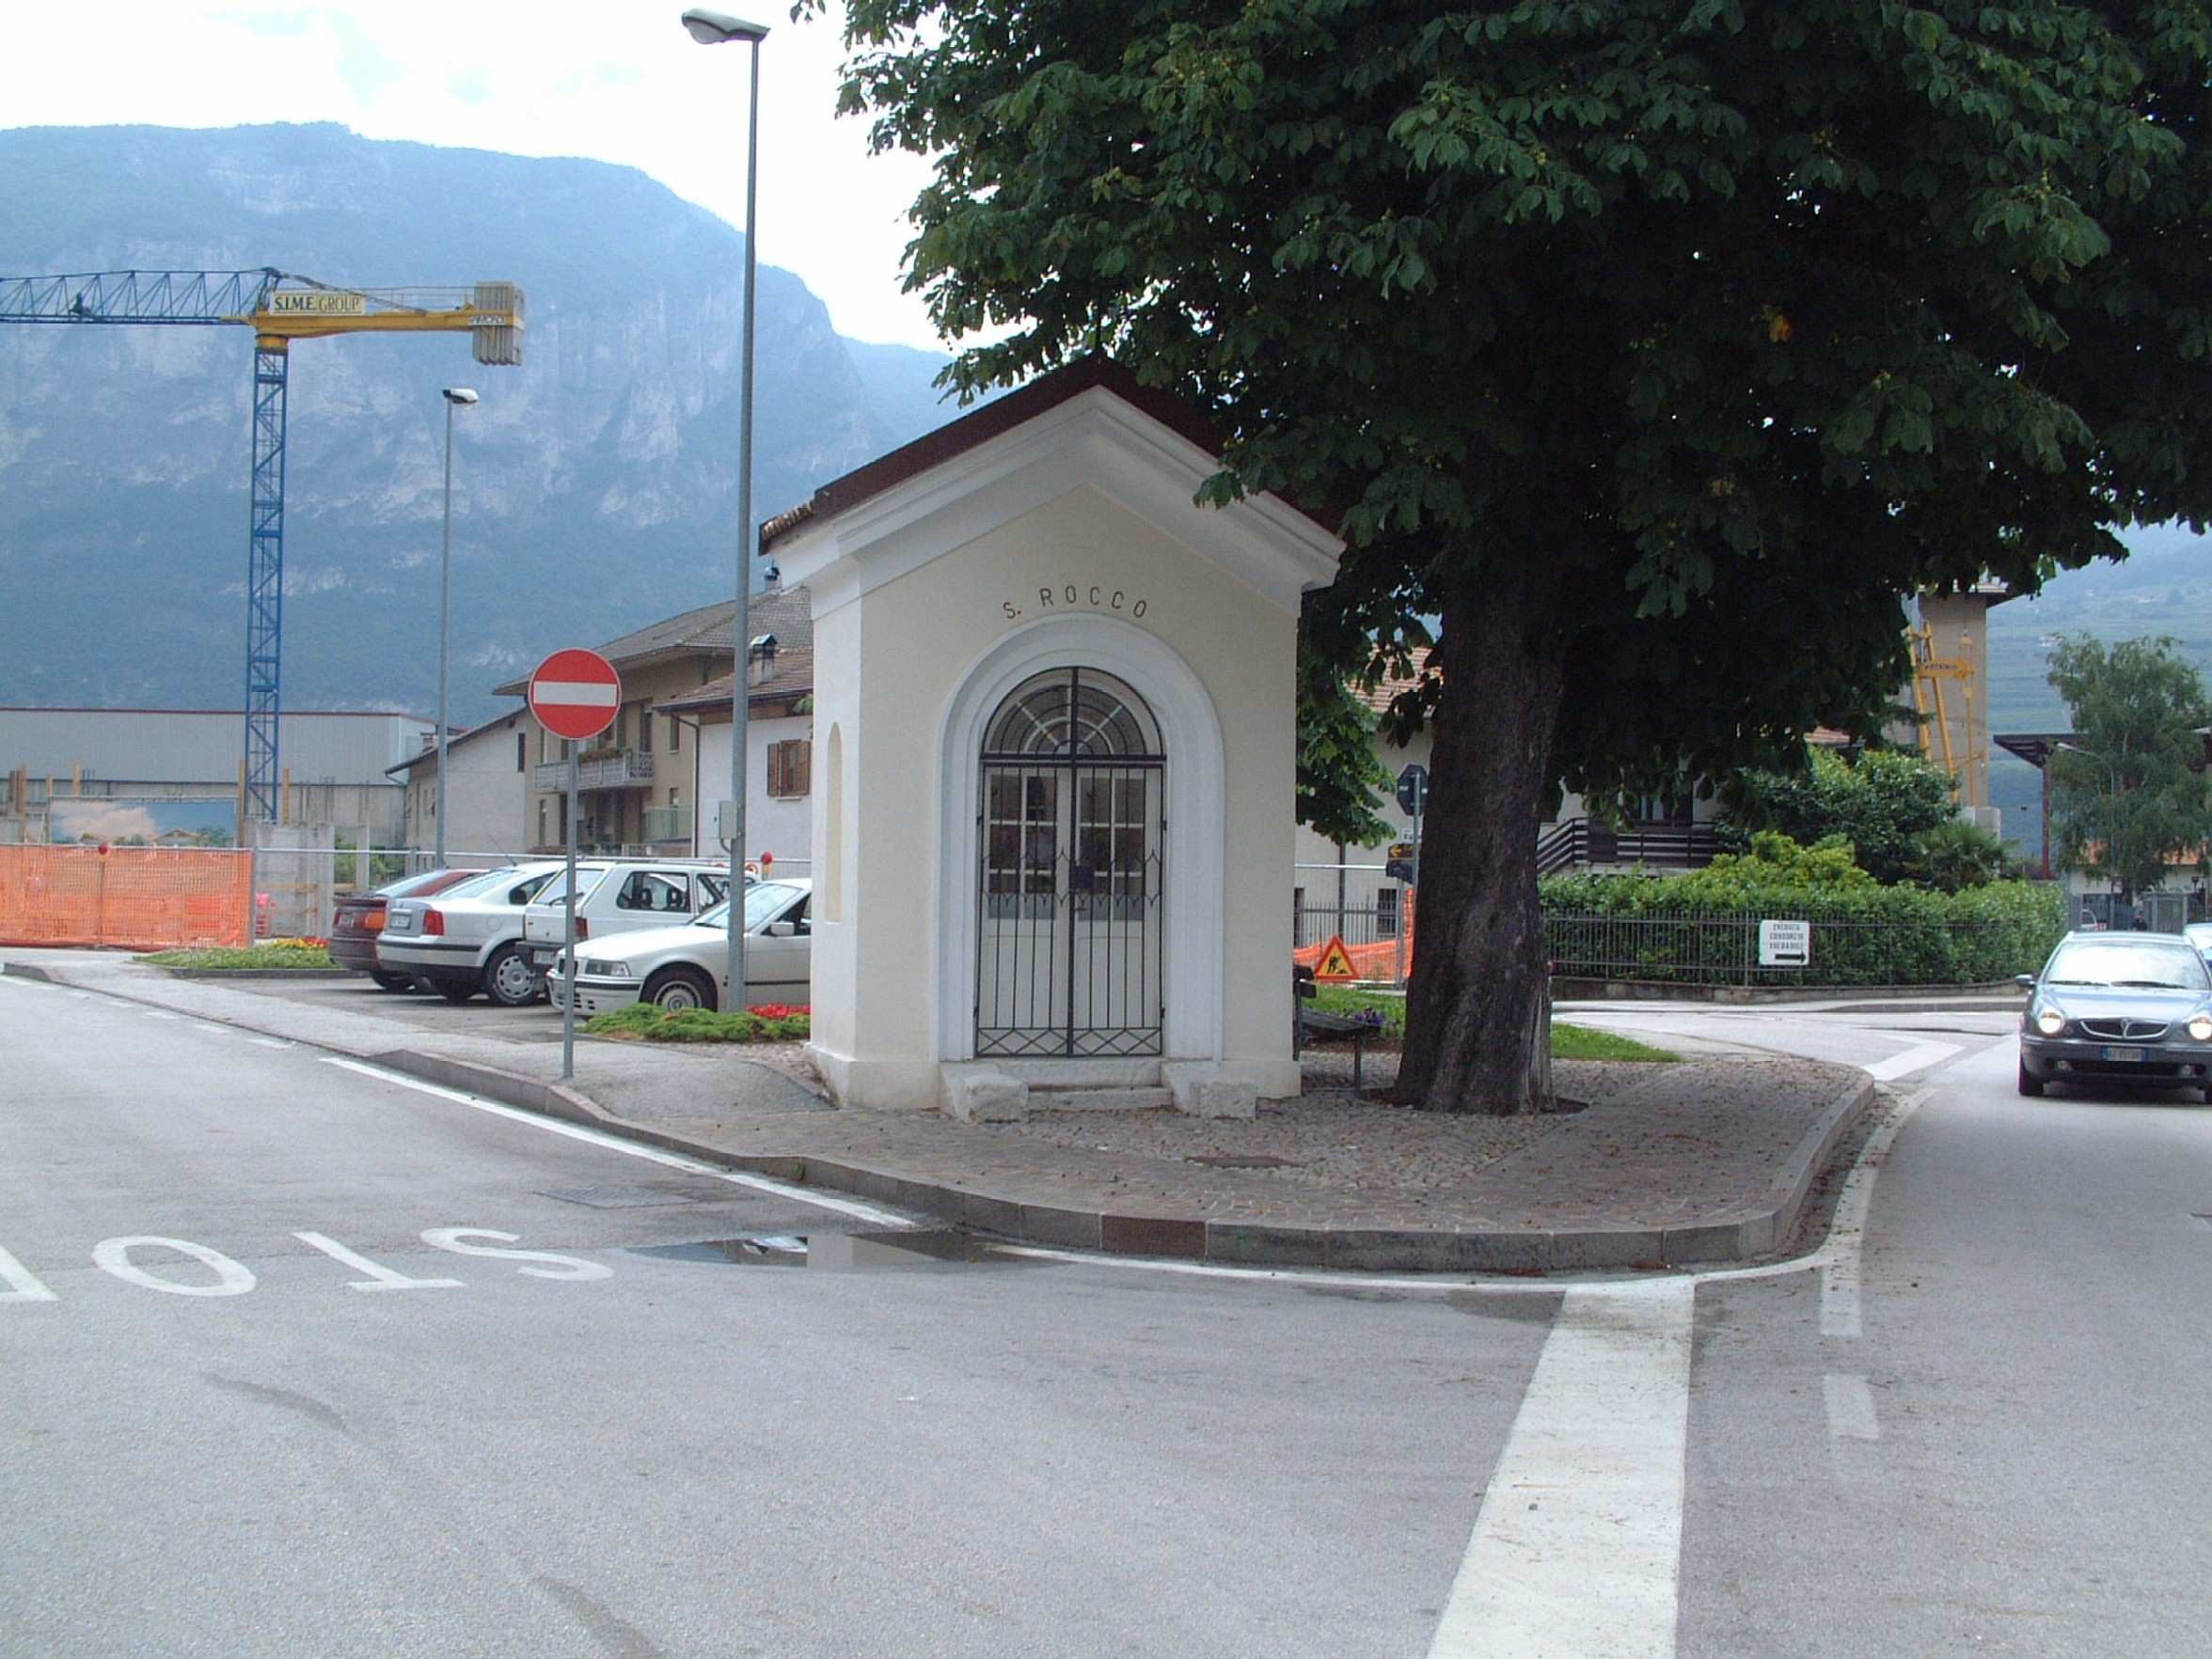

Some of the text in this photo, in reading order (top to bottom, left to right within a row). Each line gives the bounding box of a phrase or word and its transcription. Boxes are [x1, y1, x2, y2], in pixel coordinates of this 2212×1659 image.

[318, 295, 359, 311] GROUP
[1003, 585, 1147, 619] S. ROCCO
